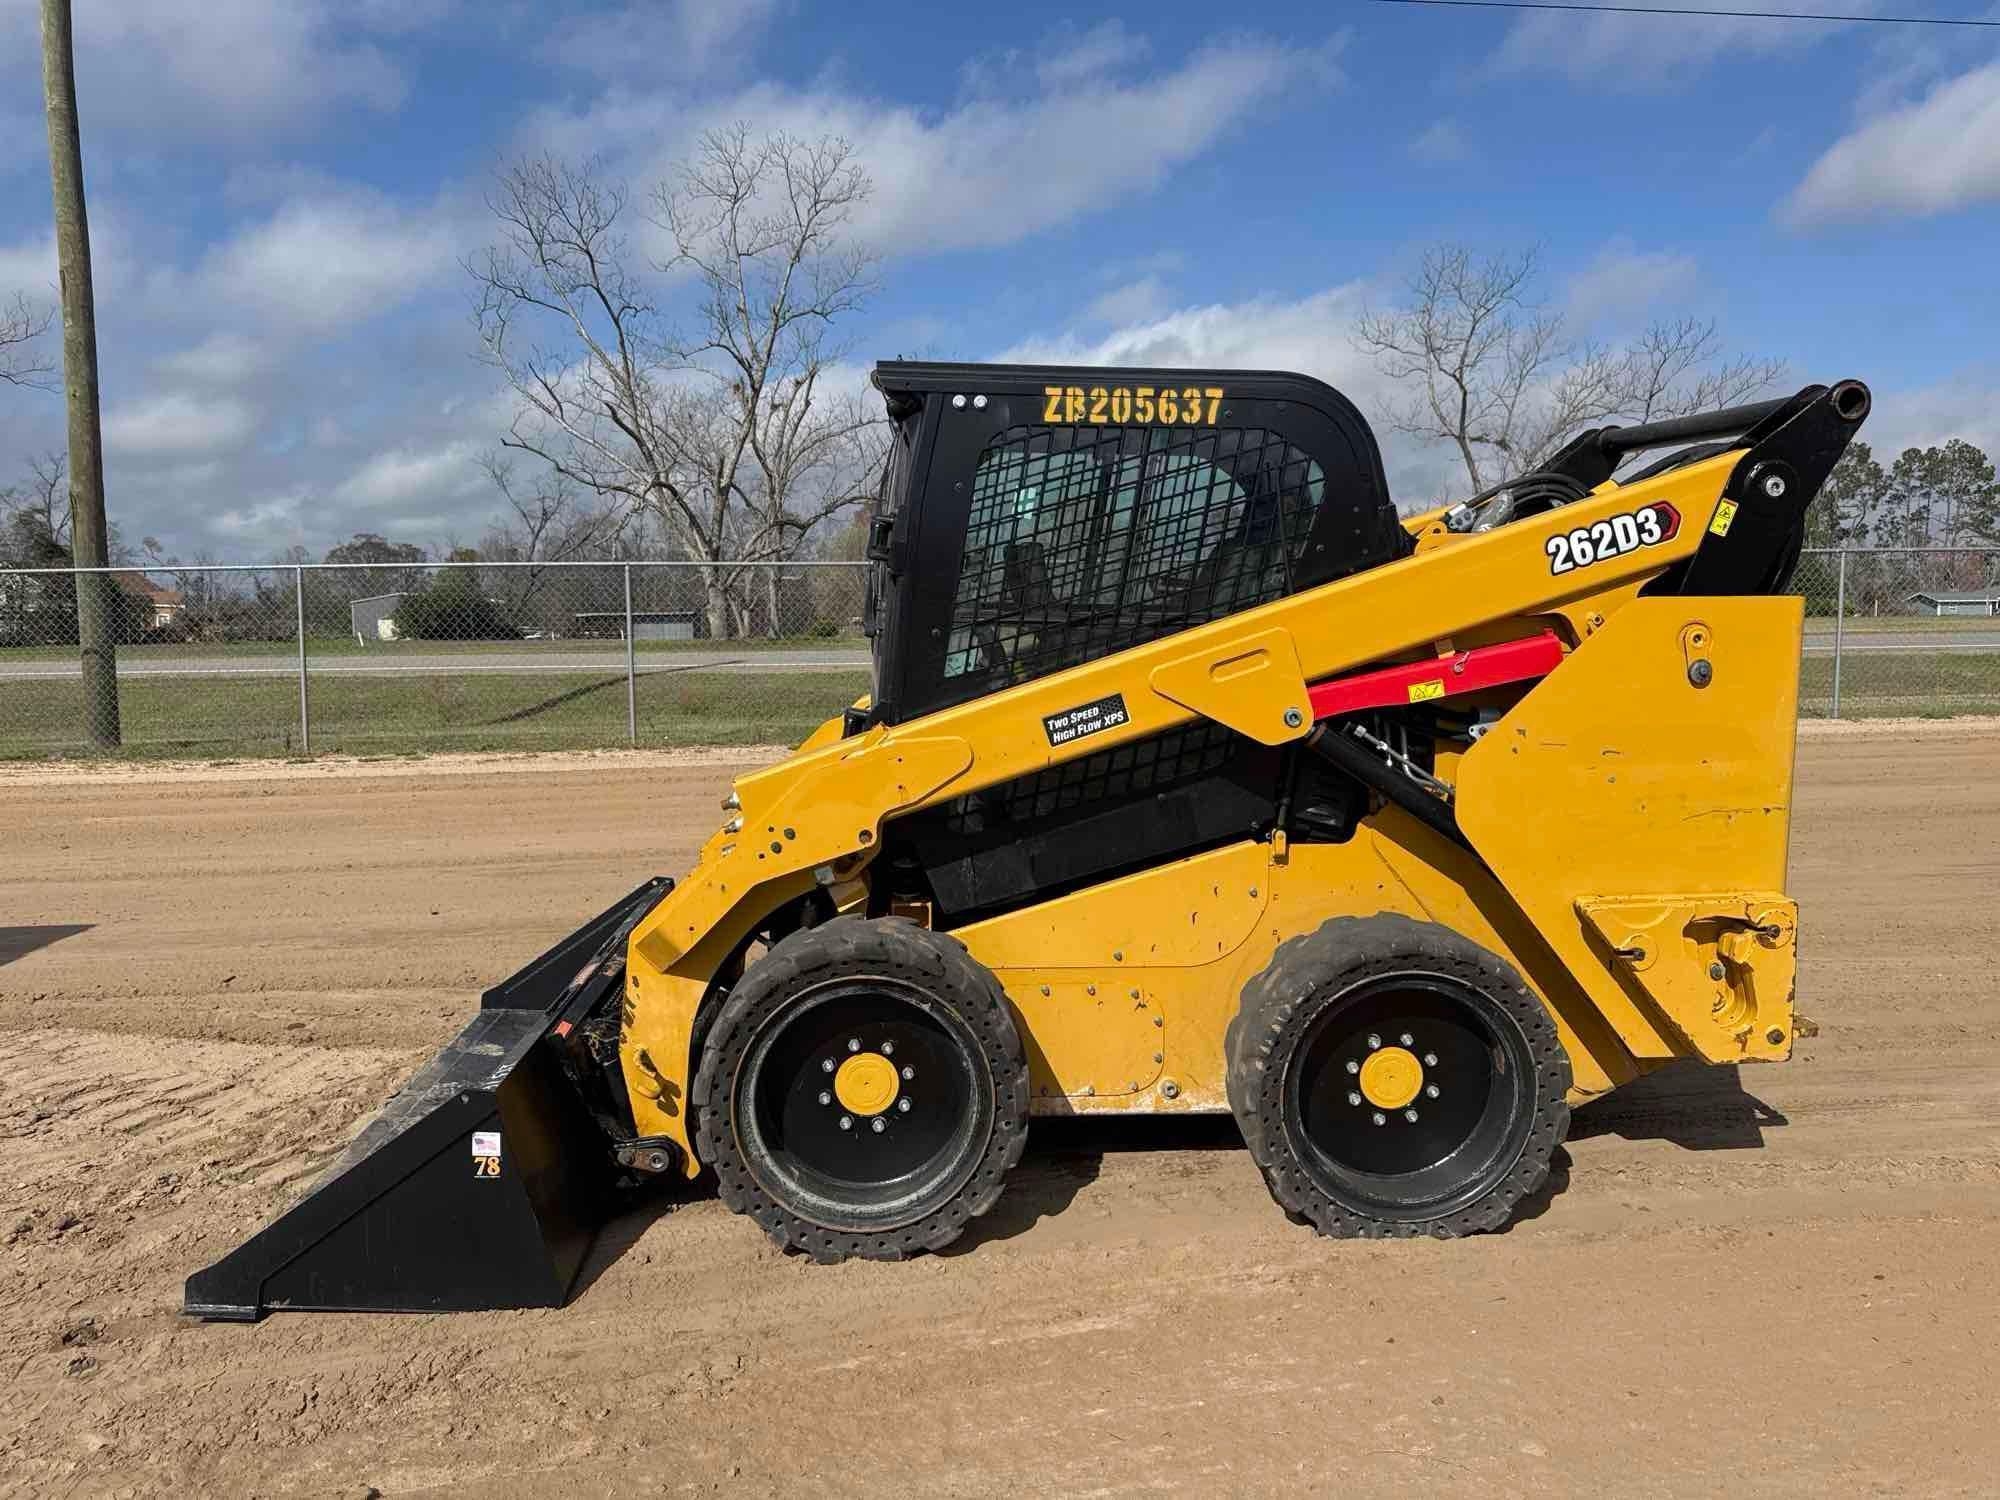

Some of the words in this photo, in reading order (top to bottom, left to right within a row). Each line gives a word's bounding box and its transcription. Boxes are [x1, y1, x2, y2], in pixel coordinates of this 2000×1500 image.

[1044, 386, 1224, 425] ZB205637
[1547, 507, 1662, 574] 262D3
[1104, 711, 1124, 726] XPS
[474, 1157, 501, 1176] 78
